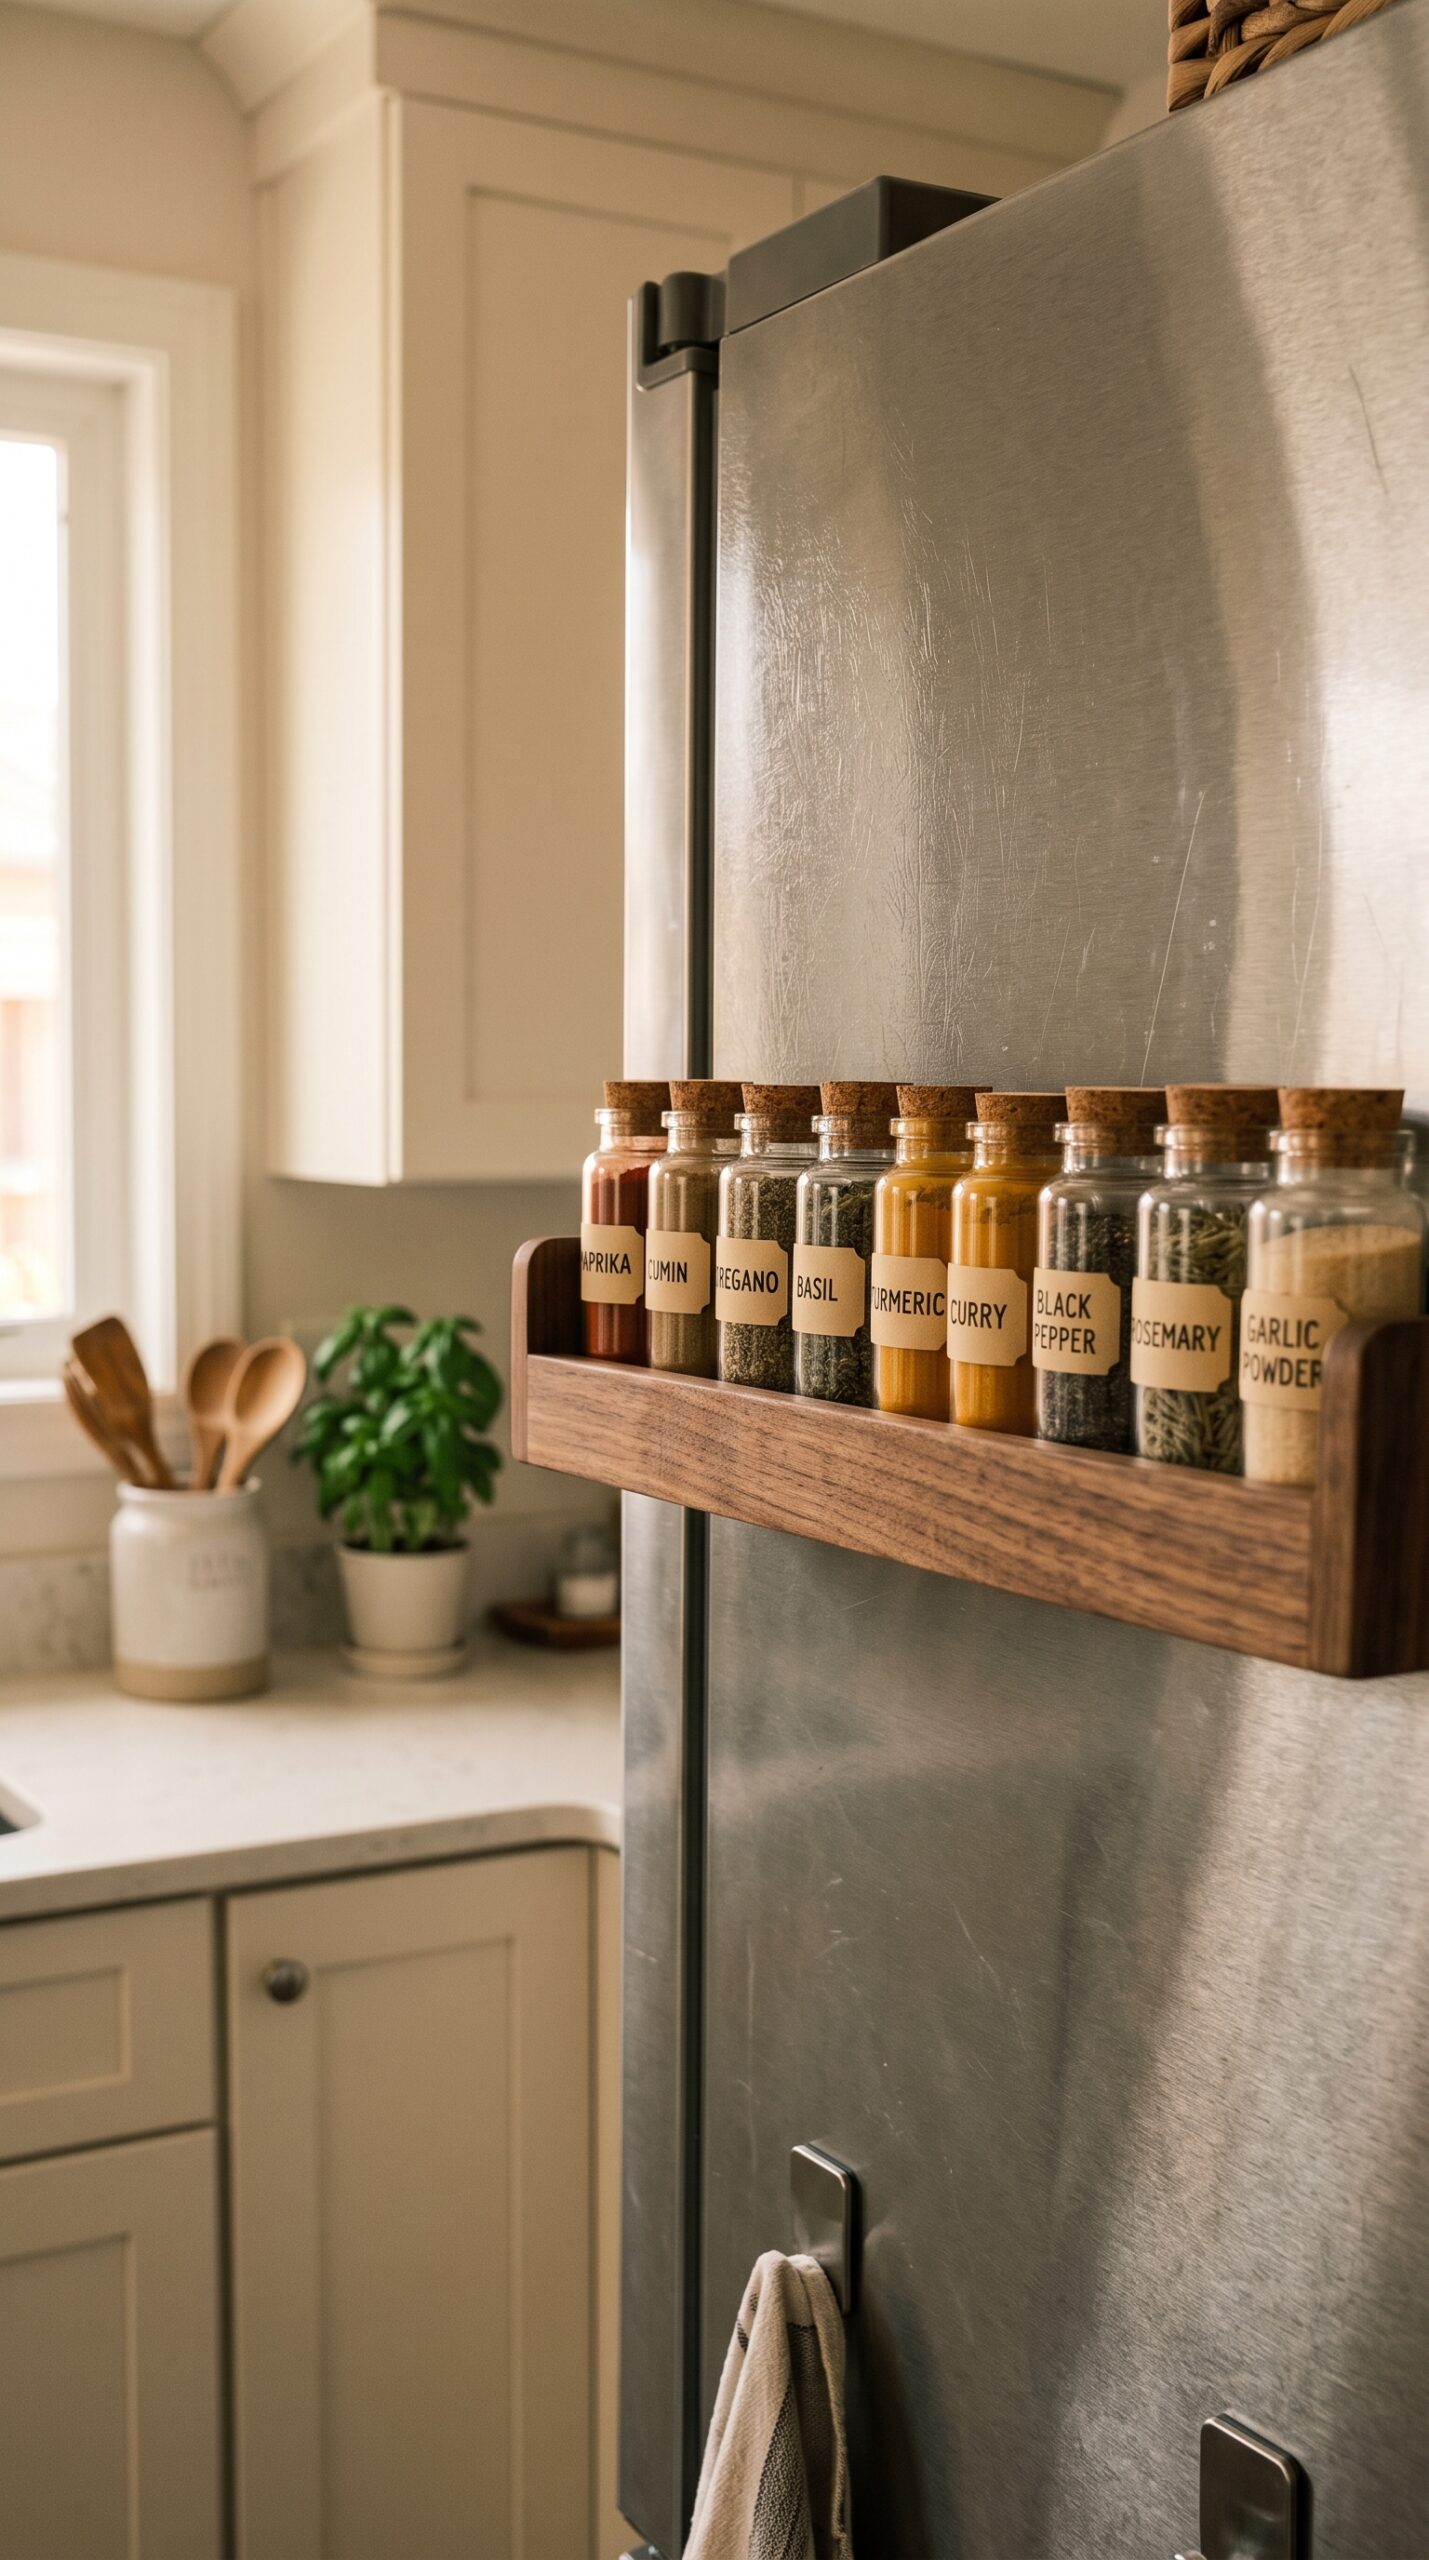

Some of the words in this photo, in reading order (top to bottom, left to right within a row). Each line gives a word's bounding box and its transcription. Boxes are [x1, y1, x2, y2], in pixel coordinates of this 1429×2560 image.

[581, 1251, 632, 1275] APRIKA
[648, 1258, 688, 1284] CUMIN
[797, 1275, 838, 1302] BASIL
[950, 1299, 1008, 1329] CURRY
[1037, 1289, 1092, 1319] BLACK
[1035, 1323, 1096, 1354] PEPPER
[1247, 1314, 1319, 1350] GARLIC
[1243, 1351, 1322, 1389] POWDER
